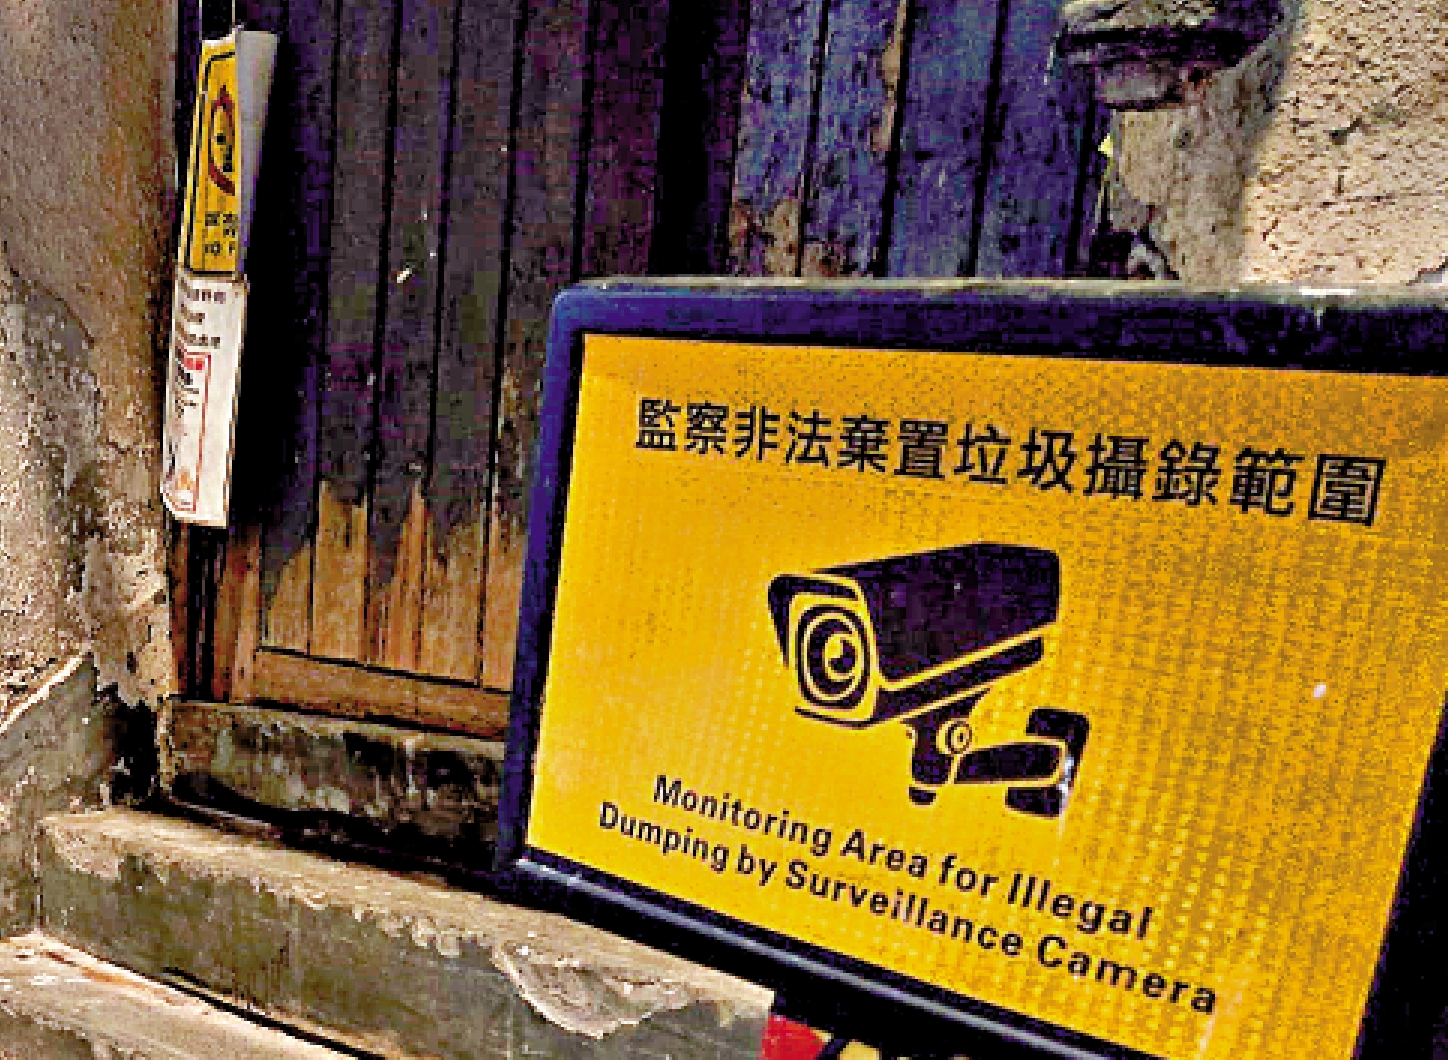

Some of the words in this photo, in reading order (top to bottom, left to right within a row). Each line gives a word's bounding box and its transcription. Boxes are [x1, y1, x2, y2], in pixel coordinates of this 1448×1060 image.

[636, 398, 1386, 527] 監察非法棄置垃圾攝錄範圍
[599, 801, 729, 874] Dumping
[736, 844, 778, 886] by
[784, 858, 1023, 957] Surveillance
[1037, 934, 1216, 1015] Camera
[652, 774, 832, 857] Monitoring
[839, 828, 928, 879] Area
[938, 853, 1000, 897] for
[1008, 871, 1152, 940] Illegal
